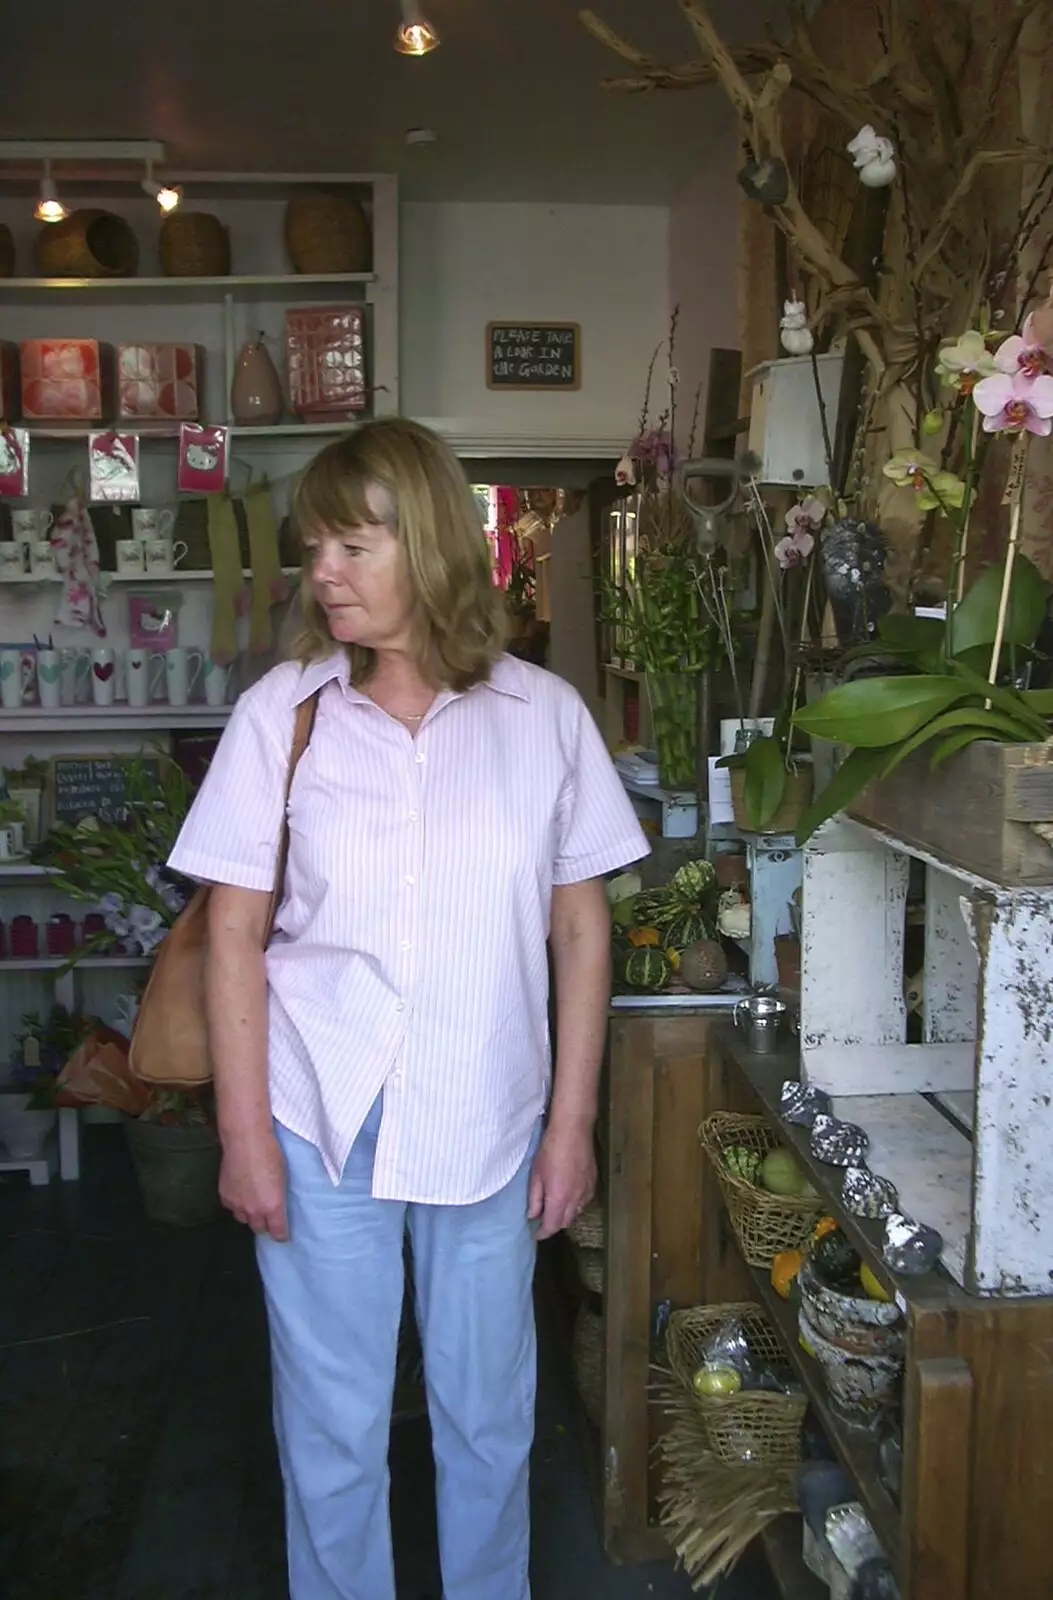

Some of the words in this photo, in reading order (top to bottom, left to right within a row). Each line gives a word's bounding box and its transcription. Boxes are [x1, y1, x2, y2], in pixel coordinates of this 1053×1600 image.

[493, 329, 541, 343] PLEASE
[494, 345, 503, 359] A
[507, 345, 534, 358] LOOK
[538, 347, 562, 358] IN
